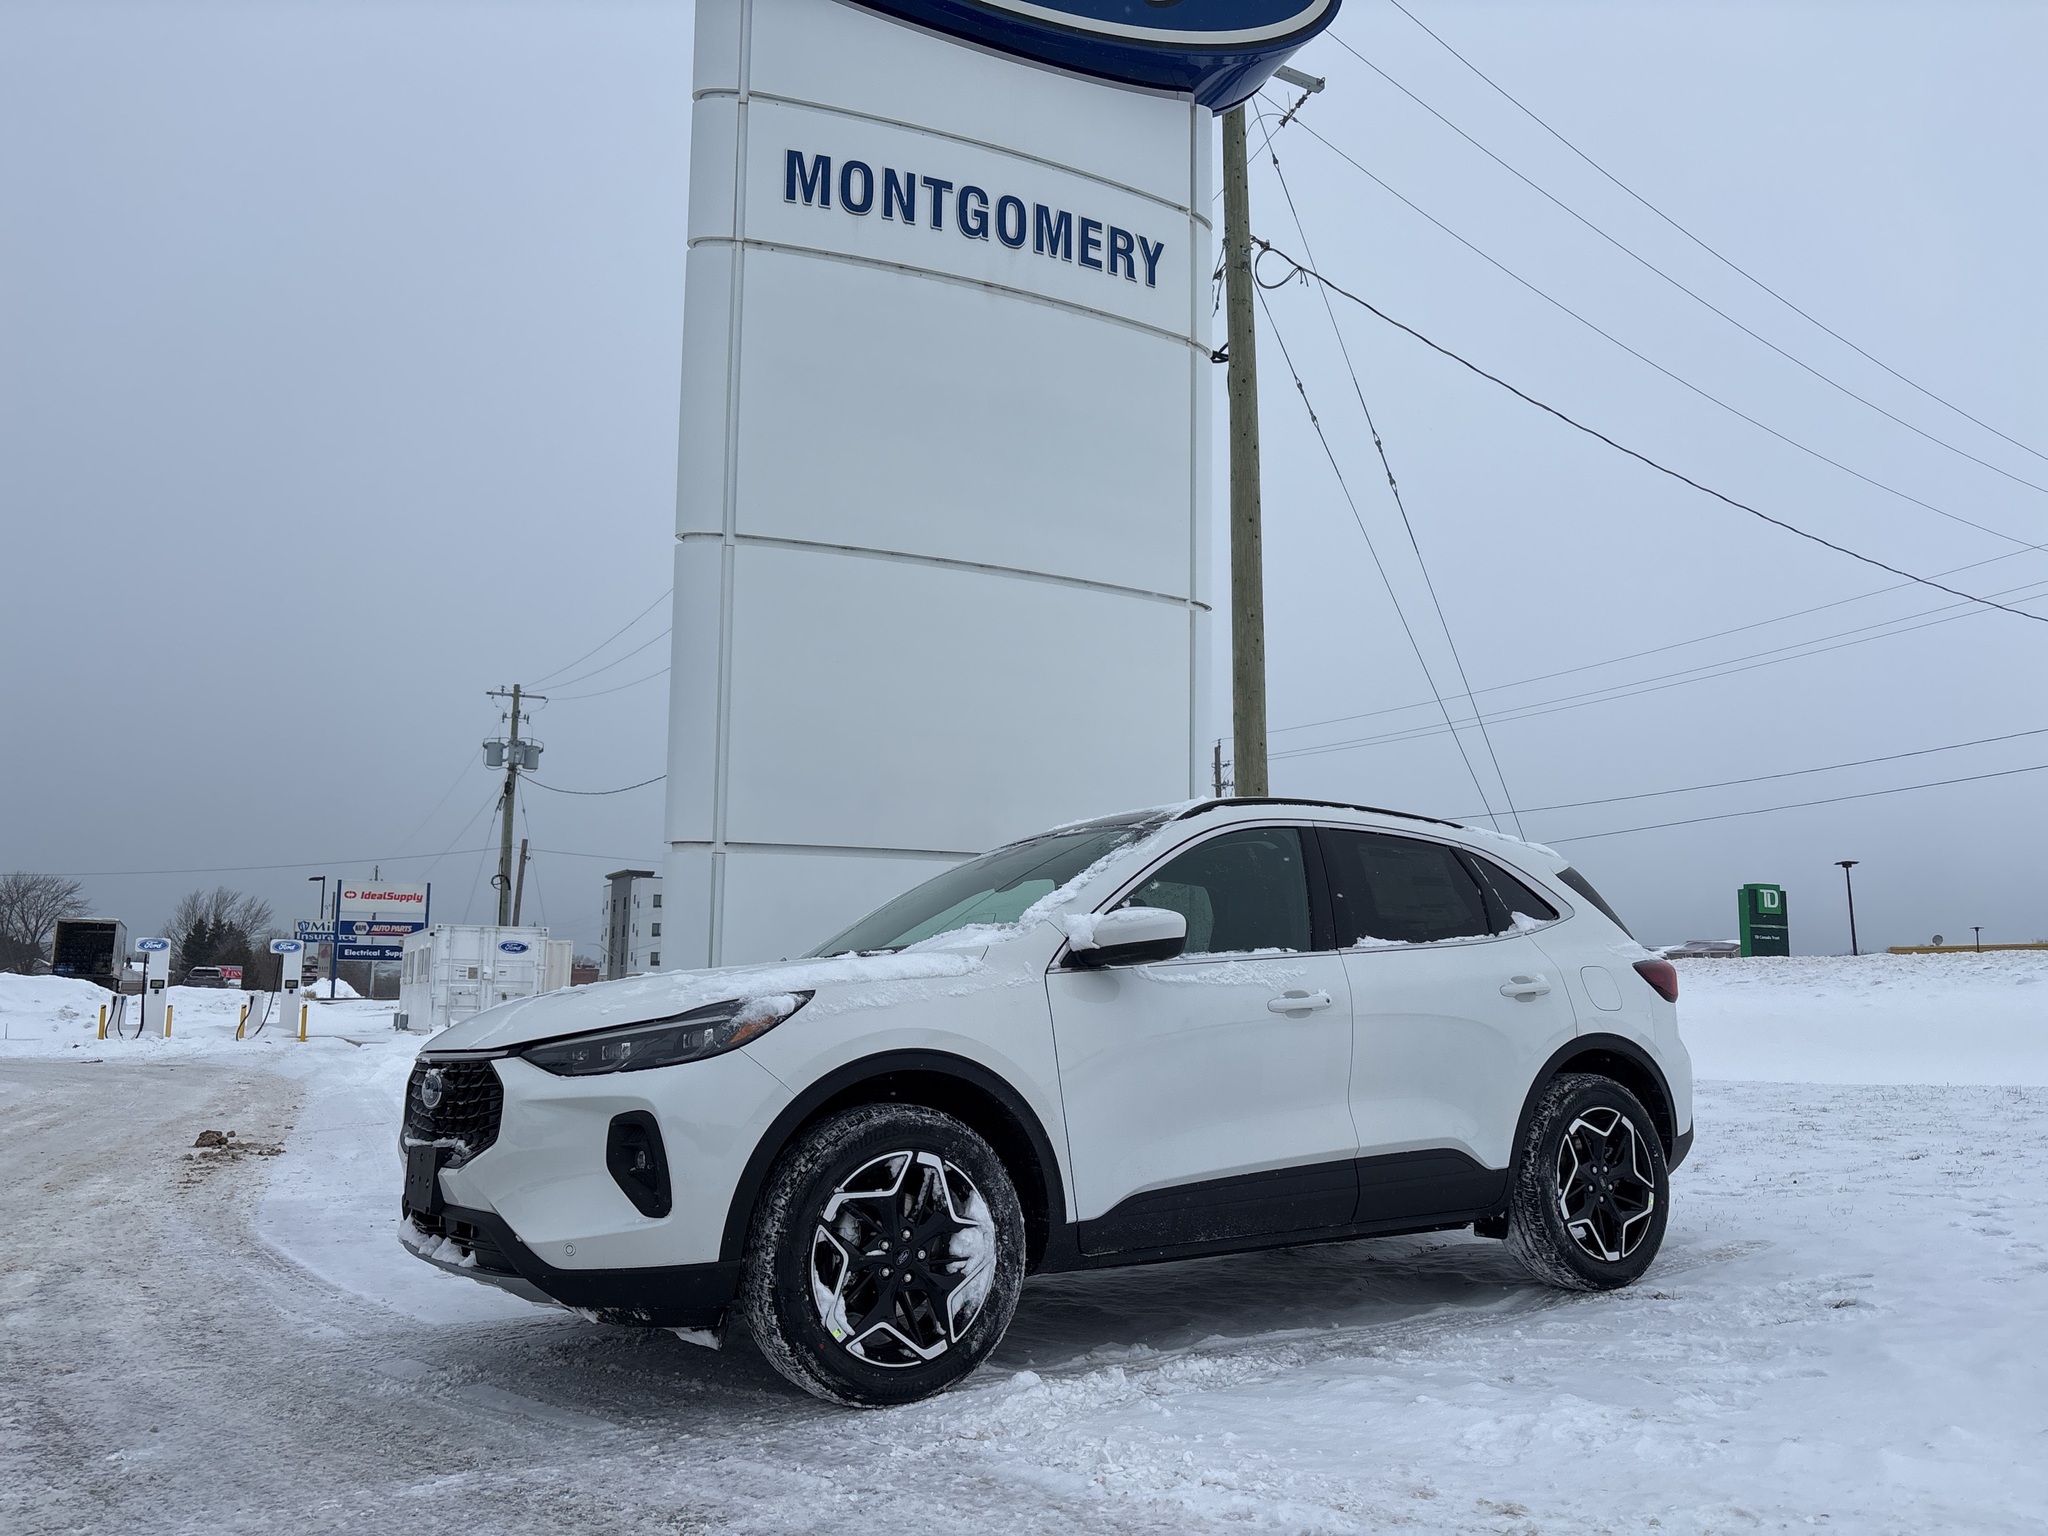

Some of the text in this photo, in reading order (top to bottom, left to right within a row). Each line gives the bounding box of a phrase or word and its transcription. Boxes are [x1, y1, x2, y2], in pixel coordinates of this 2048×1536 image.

[784, 148, 1164, 288] MONTGOMERY
[360, 891, 423, 903] IdealSupply
[1760, 889, 1778, 908] TD
[371, 924, 390, 932] AUTO
[391, 925, 412, 933] PARTS
[296, 932, 356, 941] Insurace
